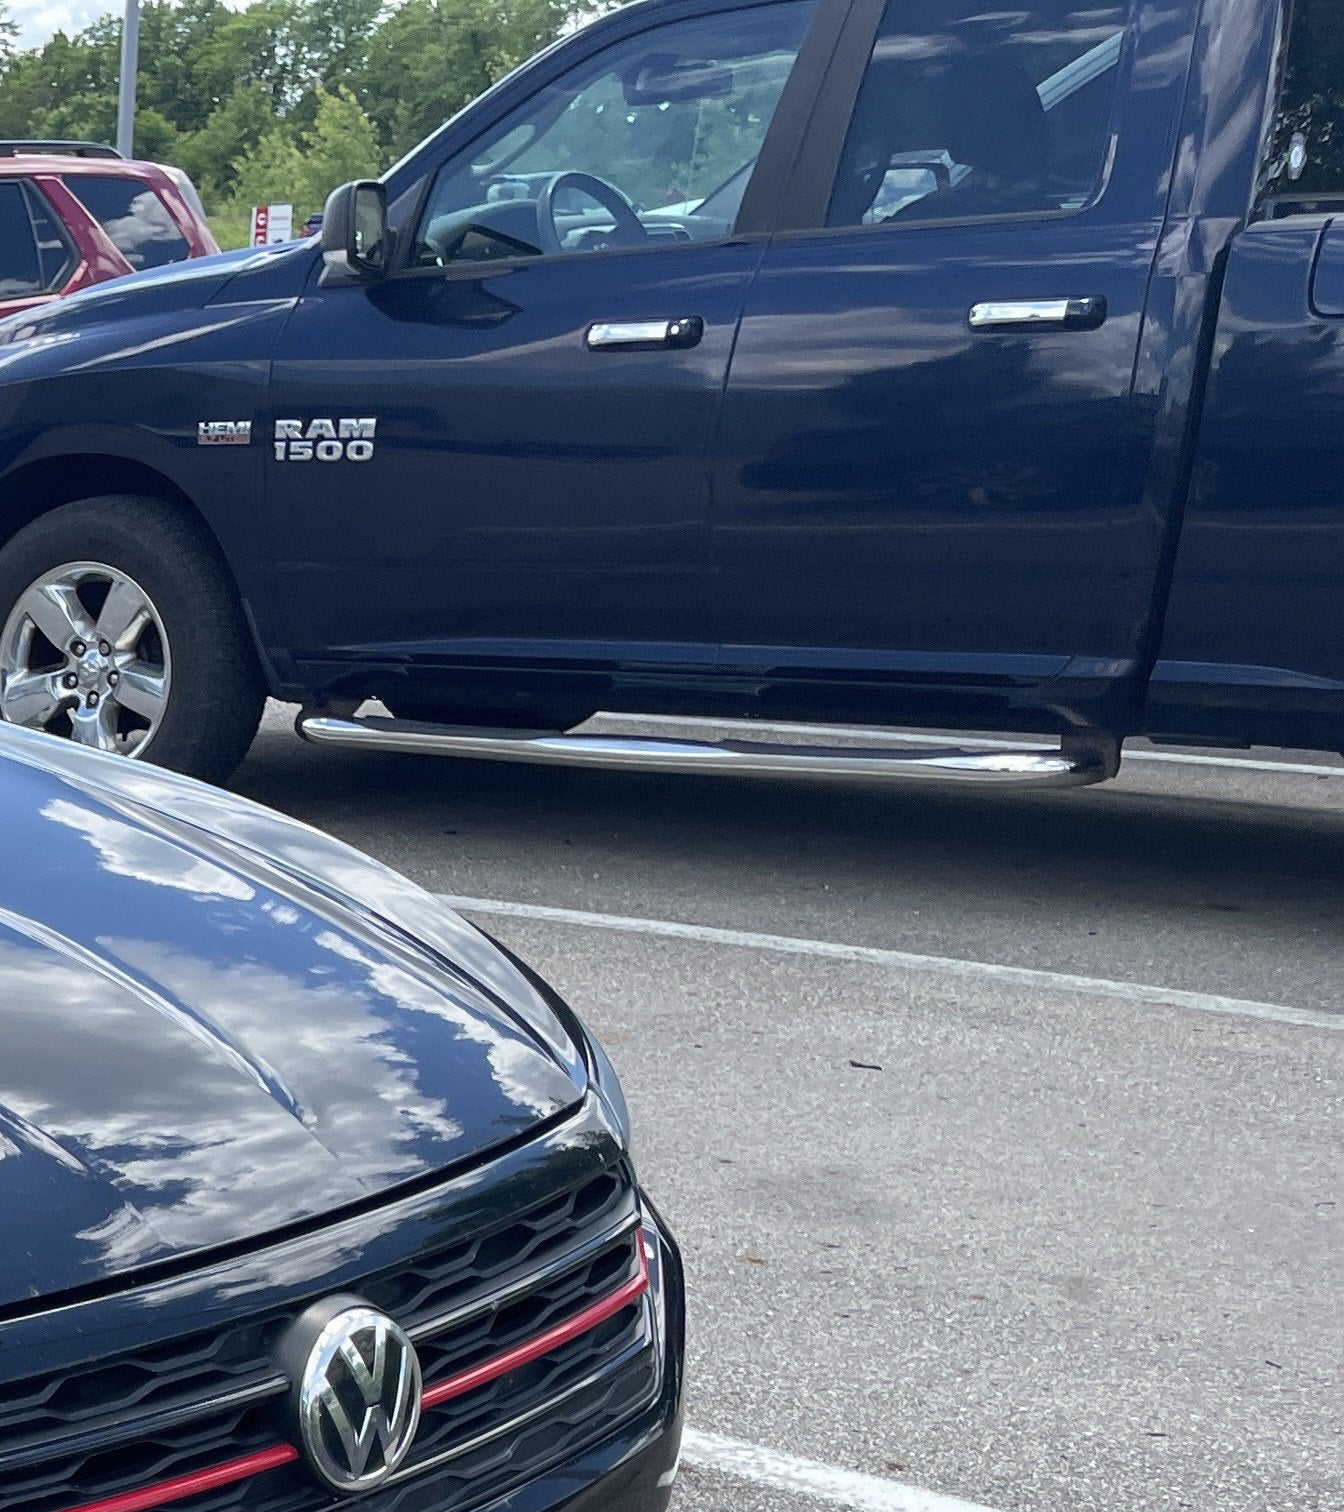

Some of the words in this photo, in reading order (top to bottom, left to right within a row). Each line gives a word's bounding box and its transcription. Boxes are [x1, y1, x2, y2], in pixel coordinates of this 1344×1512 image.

[198, 420, 252, 434] HEMI
[274, 417, 377, 439] RAM
[273, 440, 375, 462] 1500
